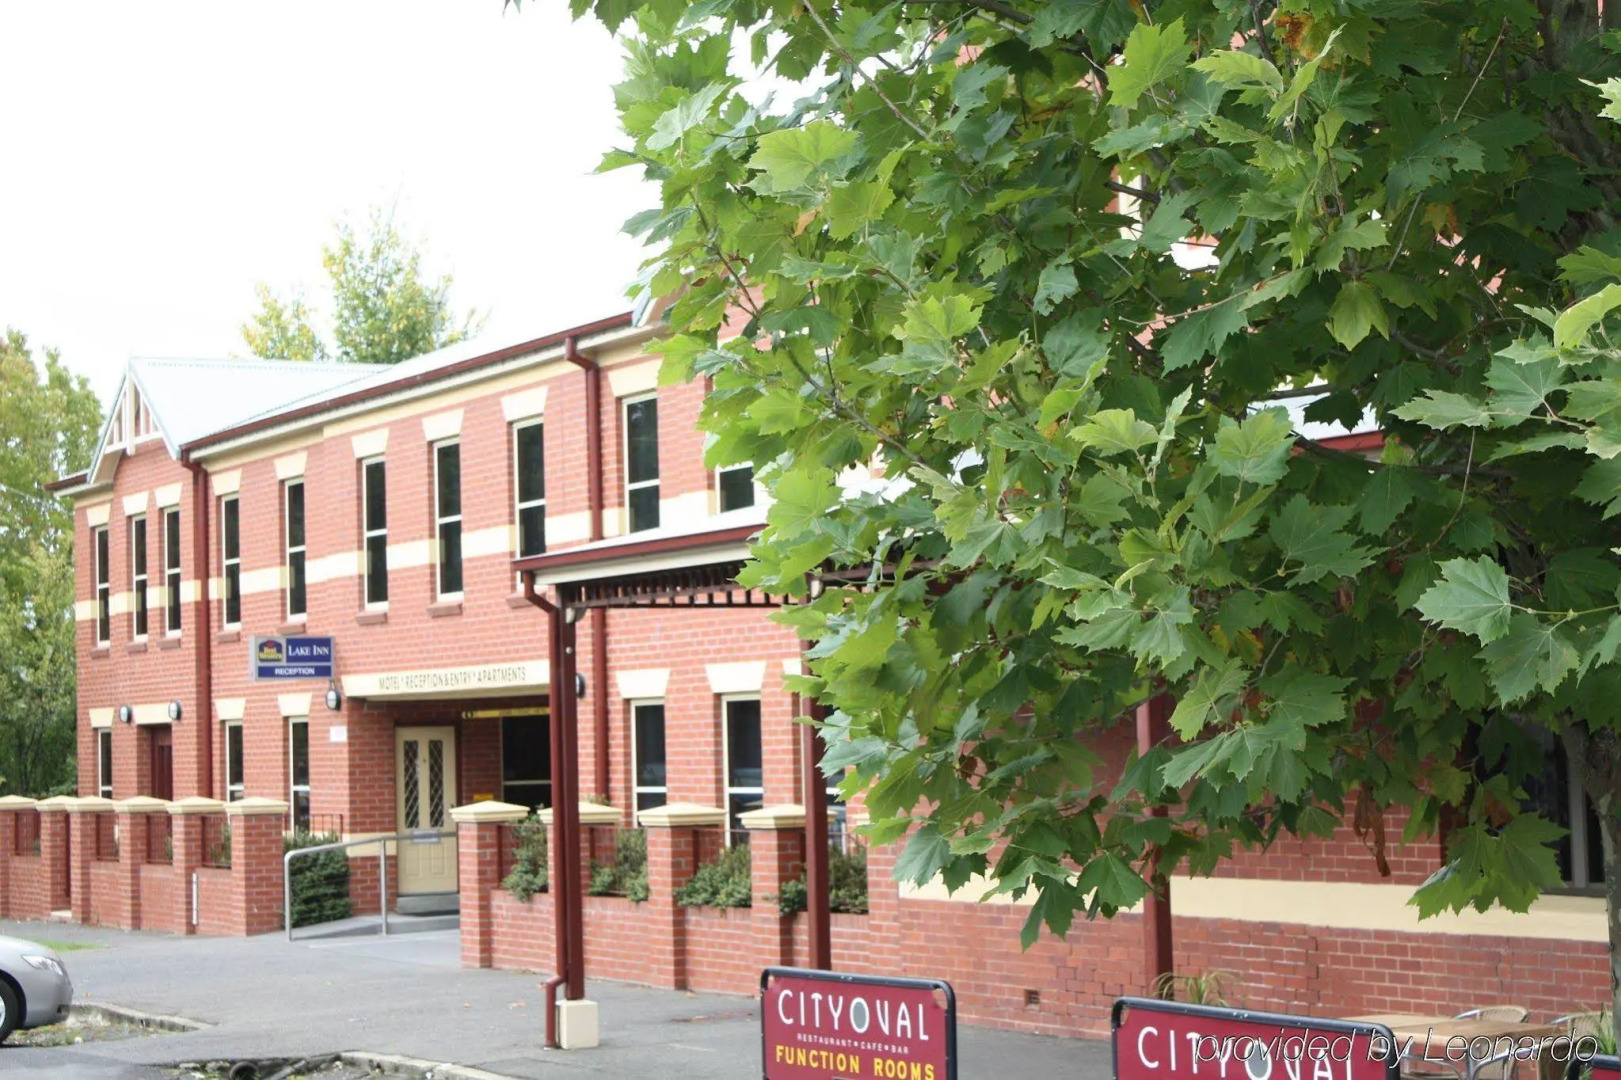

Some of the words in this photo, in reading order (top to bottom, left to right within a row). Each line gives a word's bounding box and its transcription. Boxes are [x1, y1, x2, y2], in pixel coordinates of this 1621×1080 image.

[288, 644, 311, 656] LAKE
[313, 644, 329, 656] INN
[274, 667, 315, 675] RECEPTION
[379, 676, 400, 690] MOTEL
[477, 666, 526, 682] APARTMENTS
[775, 1044, 860, 1074] FUNCTION
[873, 1058, 935, 1080] ROOMS
